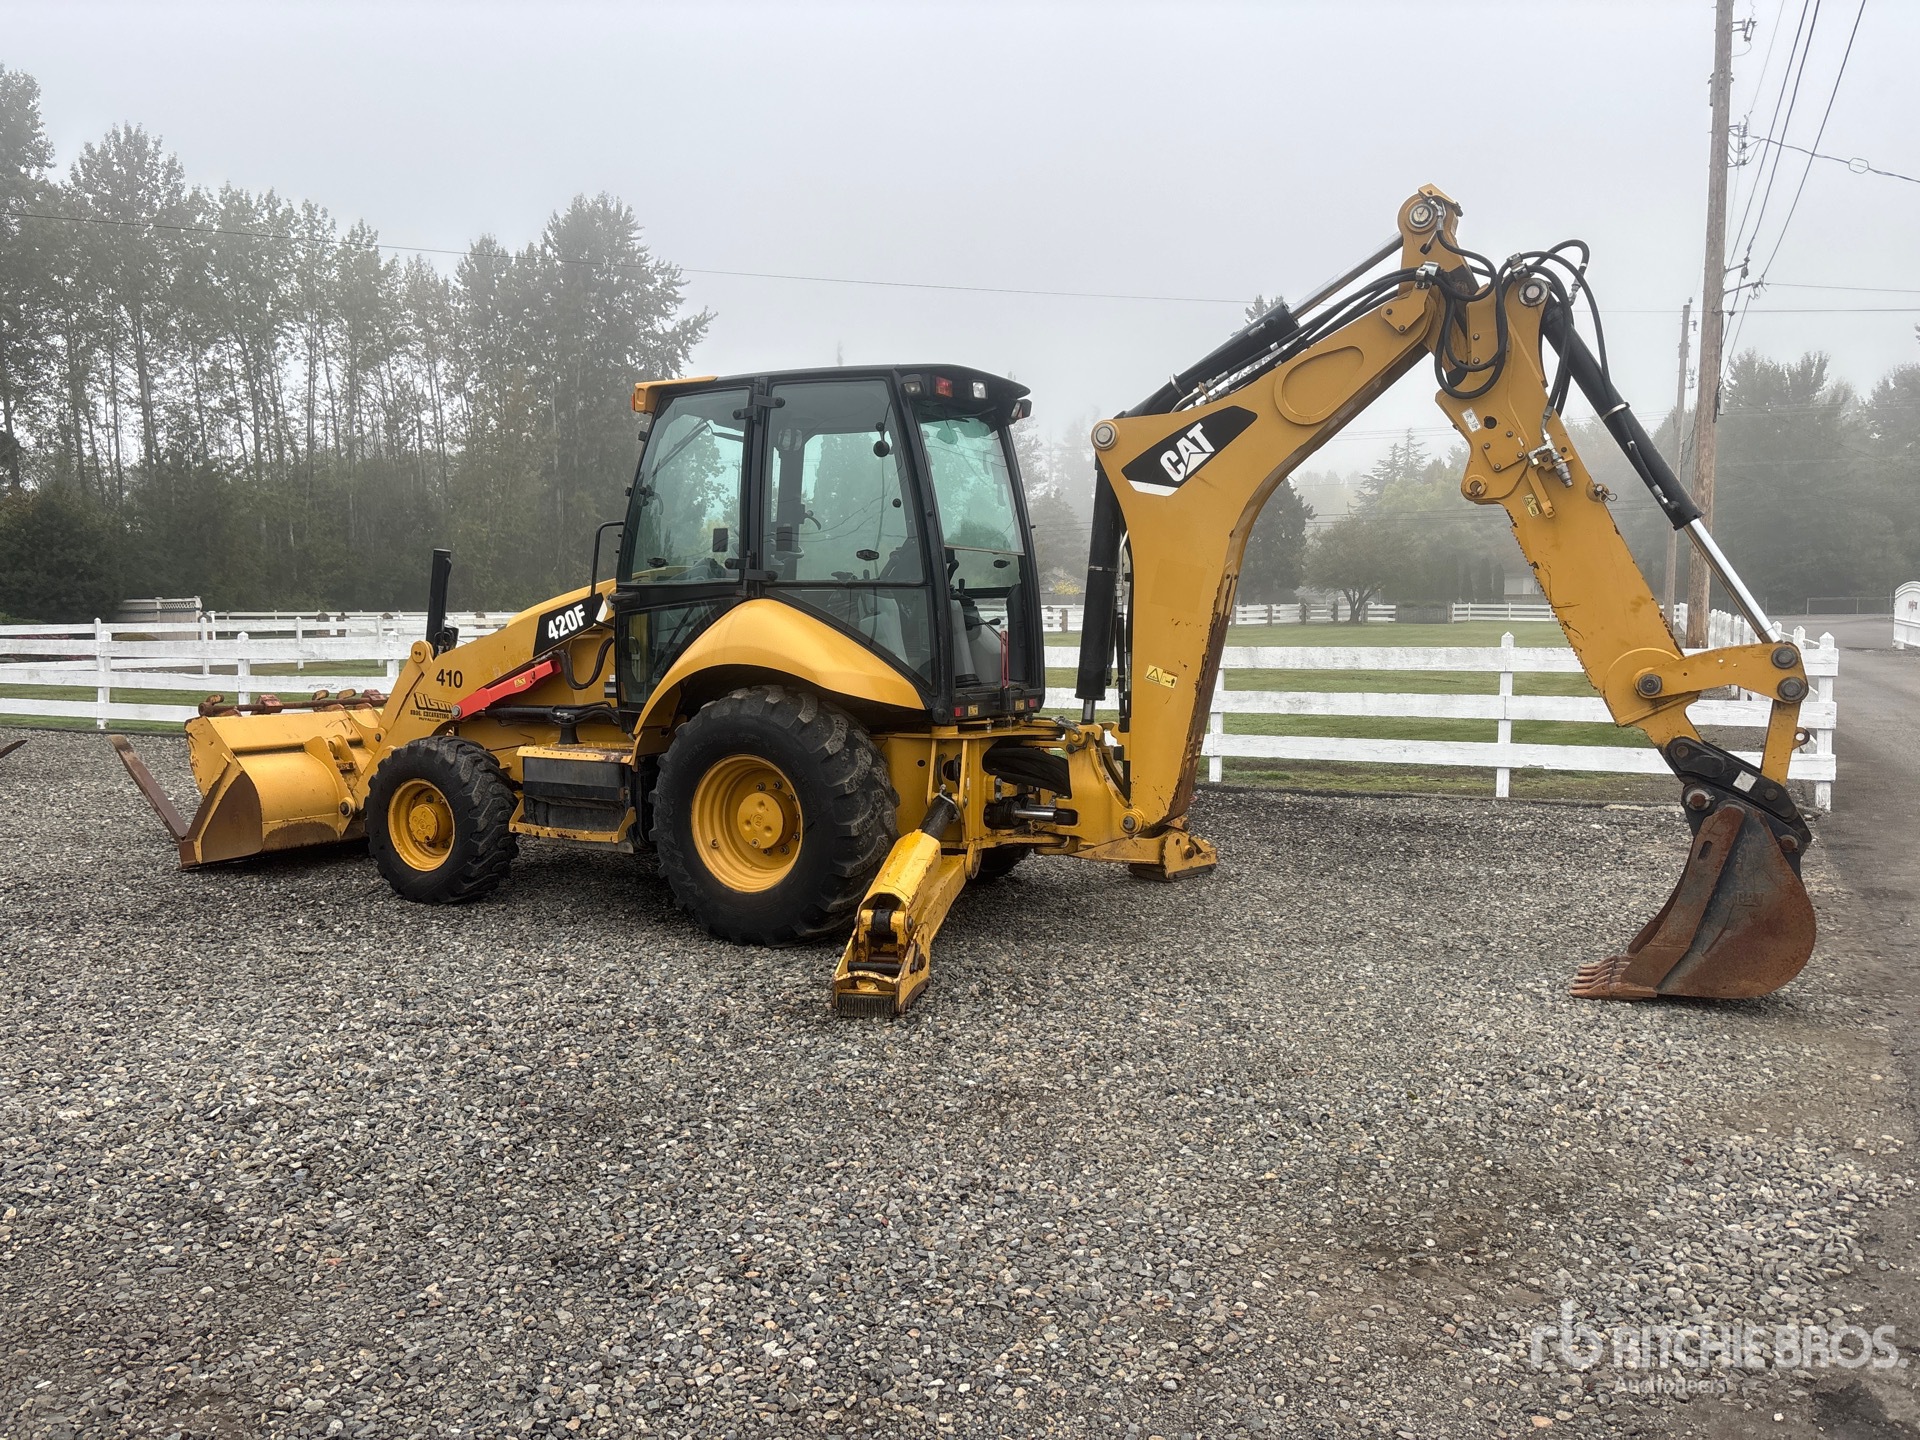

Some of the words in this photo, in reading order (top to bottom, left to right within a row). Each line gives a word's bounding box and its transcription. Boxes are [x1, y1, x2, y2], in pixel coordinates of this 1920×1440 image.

[1159, 422, 1216, 482] CAT
[547, 603, 586, 640] 420F
[436, 668, 463, 689] 410
